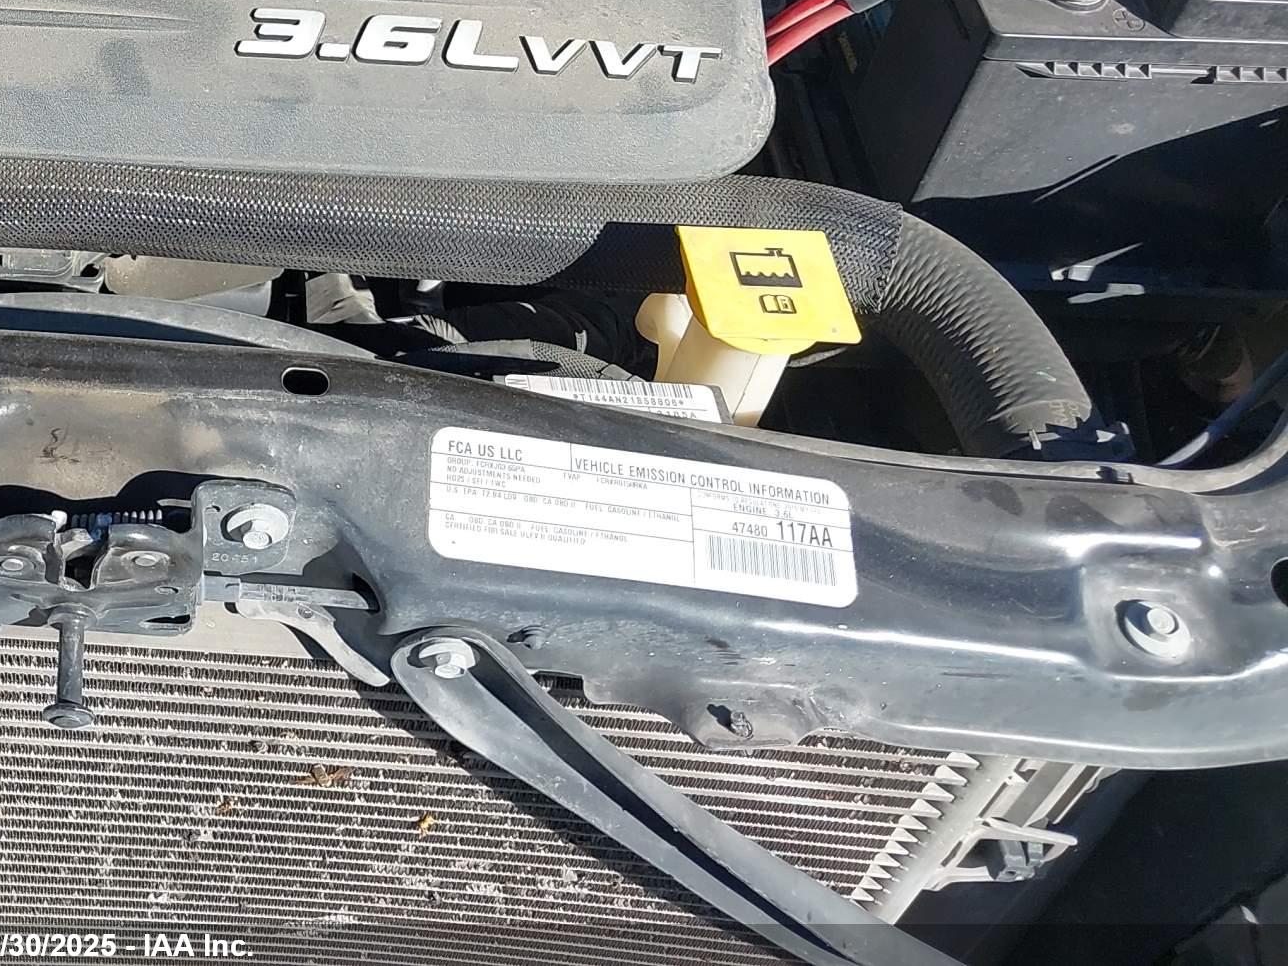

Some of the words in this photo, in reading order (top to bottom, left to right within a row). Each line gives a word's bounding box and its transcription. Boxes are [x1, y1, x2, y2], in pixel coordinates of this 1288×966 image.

[448, 440, 472, 455] FCA
[478, 444, 495, 458] US
[500, 447, 523, 462] LLC
[575, 458, 624, 476] VEHICLE
[630, 466, 685, 484] EMISSION
[690, 474, 744, 493] CONTROL
[749, 483, 830, 505] INFORMATION
[732, 522, 768, 538] 47480
[777, 520, 833, 548] 117AA
